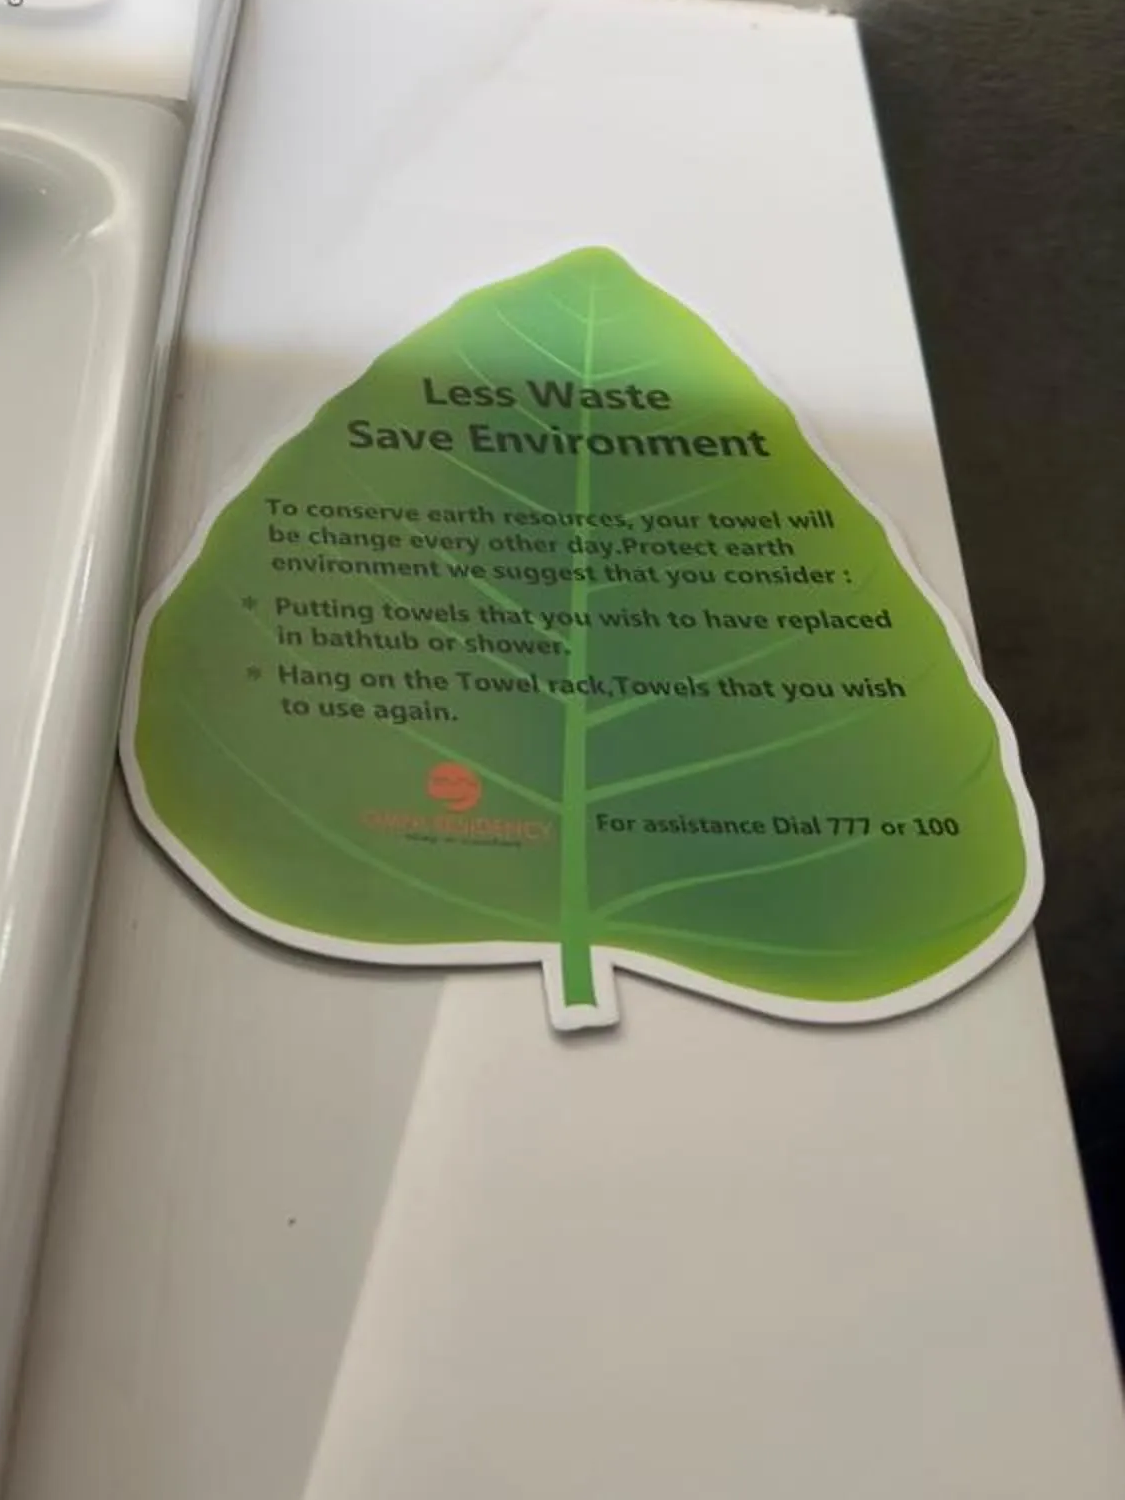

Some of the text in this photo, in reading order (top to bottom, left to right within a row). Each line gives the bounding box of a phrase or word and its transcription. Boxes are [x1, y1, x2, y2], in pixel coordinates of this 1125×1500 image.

[423, 377, 672, 411] Less Waste
[347, 420, 771, 458] Save Environment
[265, 499, 835, 532] To conserve earth resources, your towel will
[268, 524, 300, 543] be
[309, 527, 402, 551] change
[409, 537, 481, 556] every
[489, 534, 557, 554] other
[727, 539, 794, 557] earth
[271, 554, 442, 577] environment
[447, 563, 487, 579] we
[492, 563, 599, 587] suggest
[605, 566, 660, 583] that
[666, 569, 716, 589] you
[725, 566, 836, 585] consider
[276, 596, 893, 634] Putting towels that you wish to have replaced
[277, 625, 573, 656] in bathtub or shower.
[278, 664, 351, 691] Hang
[360, 671, 395, 689] on
[404, 669, 449, 691] the
[455, 671, 540, 694] Towel
[718, 676, 774, 698] that
[780, 679, 835, 703] you
[842, 677, 907, 699] wish
[280, 696, 460, 724] to use again.
[595, 813, 960, 837] For assistance Dial 777 or 100
